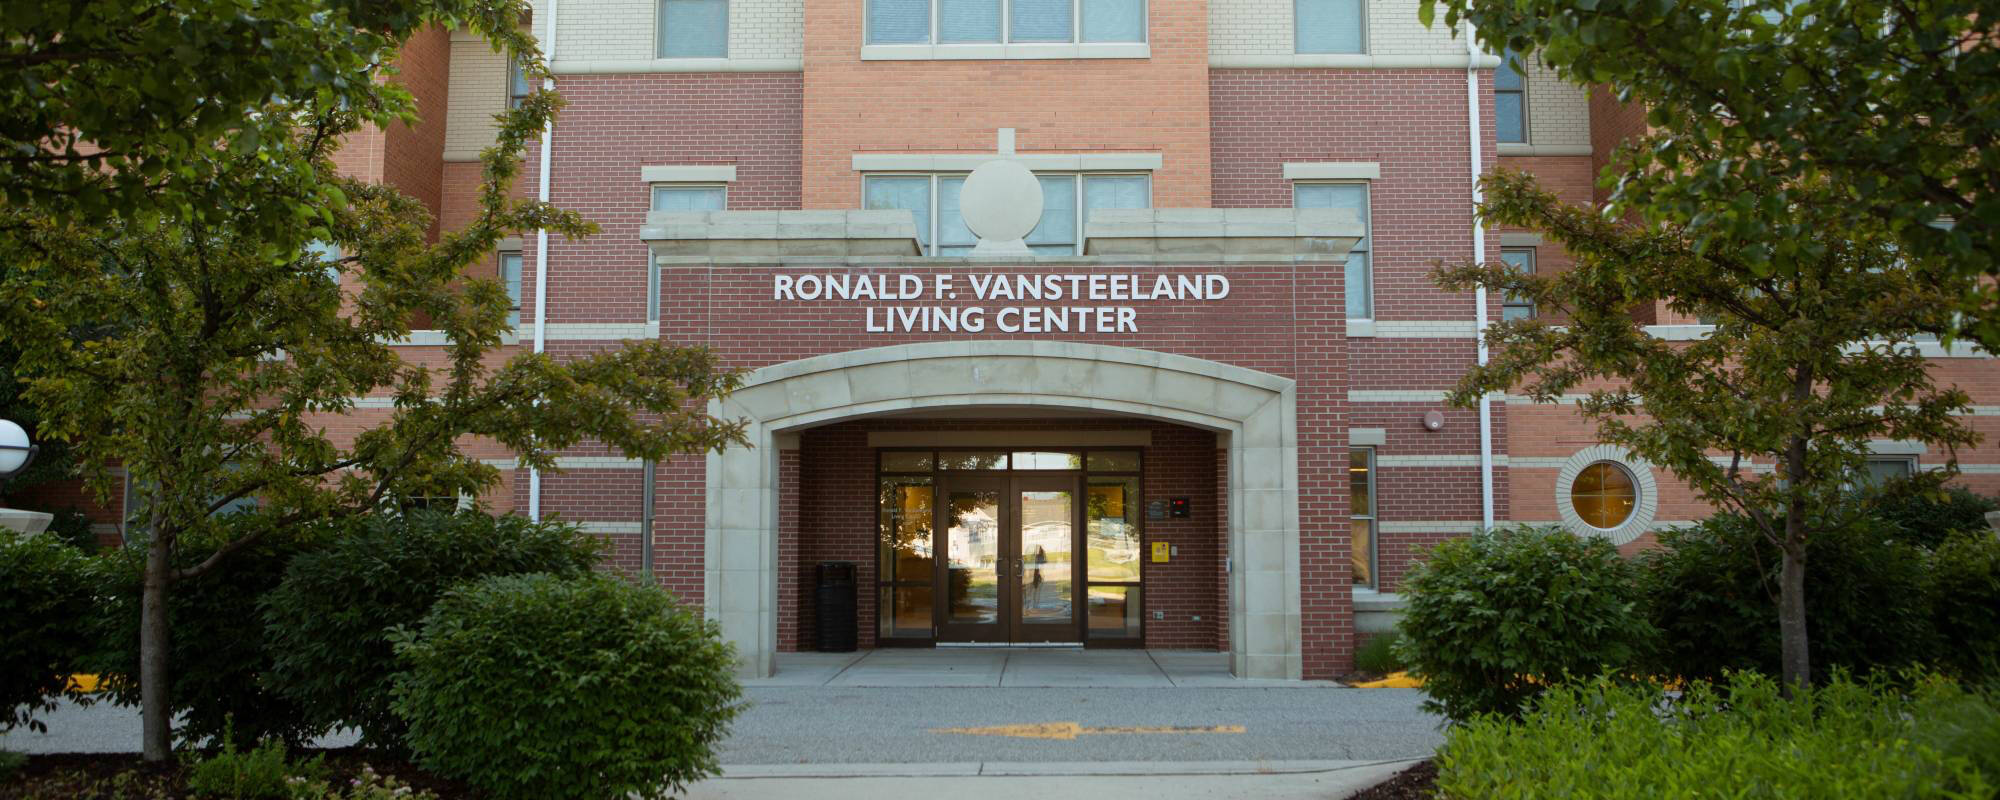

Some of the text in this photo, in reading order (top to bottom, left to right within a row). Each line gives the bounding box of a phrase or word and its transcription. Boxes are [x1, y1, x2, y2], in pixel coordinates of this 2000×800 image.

[774, 273, 1231, 301] RONALD F. VANSTEELAND
[866, 306, 1138, 333] LIVING CENTER
